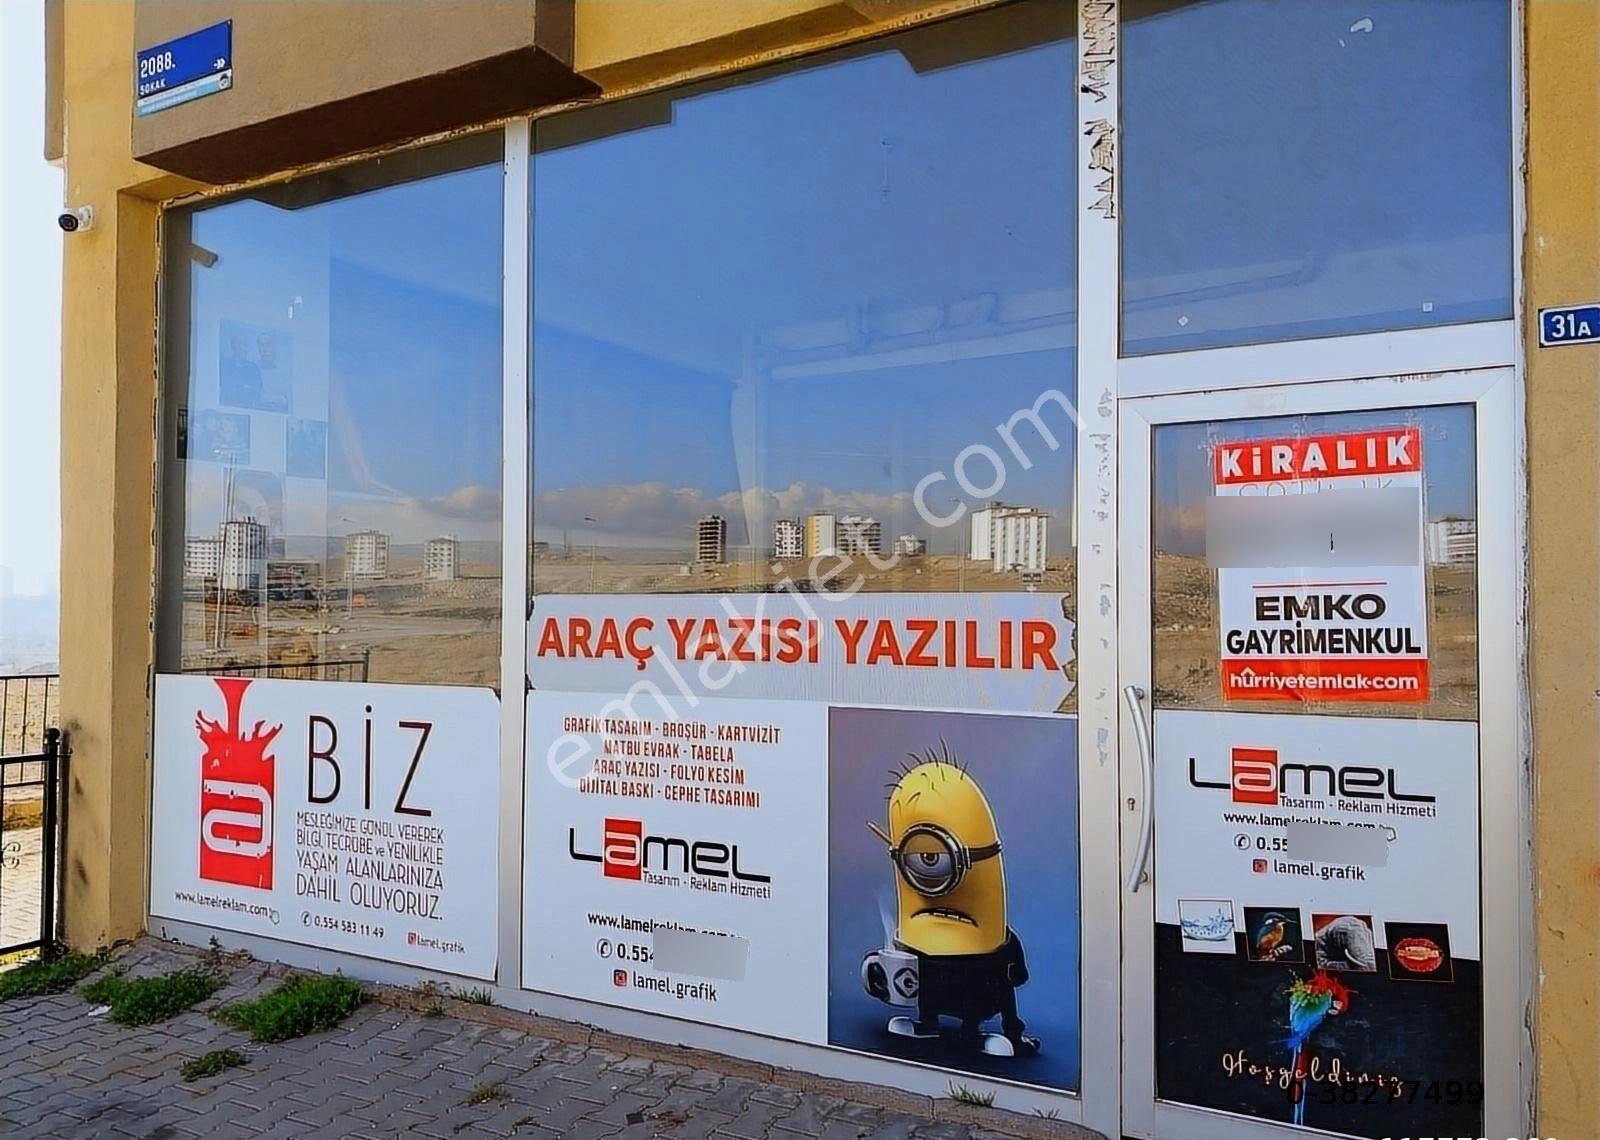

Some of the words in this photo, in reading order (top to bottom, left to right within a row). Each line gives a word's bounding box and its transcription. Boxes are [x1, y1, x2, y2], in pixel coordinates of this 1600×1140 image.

[140, 51, 176, 78] 2088.
[140, 78, 167, 96] SOKAK
[1255, 593, 1386, 621] EMKO
[536, 616, 655, 671] ARAÇ
[666, 616, 820, 665] YAZISI
[834, 618, 1061, 671] YAZILIR
[1226, 620, 1422, 655] GAYRİMENKUL
[564, 714, 601, 734] GRAFİK
[604, 719, 652, 736] TASARIM
[662, 721, 707, 741] BROŞÜR
[717, 724, 780, 744] KARTVİZİT
[307, 704, 433, 817] BİZ
[604, 739, 640, 756] MATBU
[644, 741, 679, 759] EVRAK
[691, 744, 734, 763] TABELA
[594, 758, 622, 778] ARAÇ
[625, 760, 660, 778] YAZISI
[671, 764, 705, 782] FOLYO
[707, 765, 744, 785] KESİM
[580, 776, 618, 796] DİJİTAL
[621, 781, 654, 799] BASKI
[664, 785, 701, 803] CEPHE
[703, 788, 760, 809] TASARIMI
[1280, 795, 1325, 810] Tasarım
[1338, 799, 1382, 814] Reklam
[1386, 803, 1436, 818] Hizmeti
[297, 810, 357, 833] MESLEĞİMİZE
[398, 823, 444, 844] VEREREK
[375, 846, 385, 857] ve
[387, 840, 443, 866] YENİLİKLE
[296, 849, 338, 875] YAŞAM
[345, 857, 444, 890] ALANLARINIZA
[1273, 858, 1366, 881] lamel.grafik
[296, 872, 341, 903] DAHİL
[350, 881, 443, 921] OLUYORUZ.
[643, 870, 680, 887] Tasarım
[690, 875, 727, 893] Reklam
[730, 881, 771, 899] Hizmeti
[175, 891, 268, 917] www.lamelreklam.com
[373, 926, 385, 939] 49
[633, 970, 717, 1002] lamel.grafik
